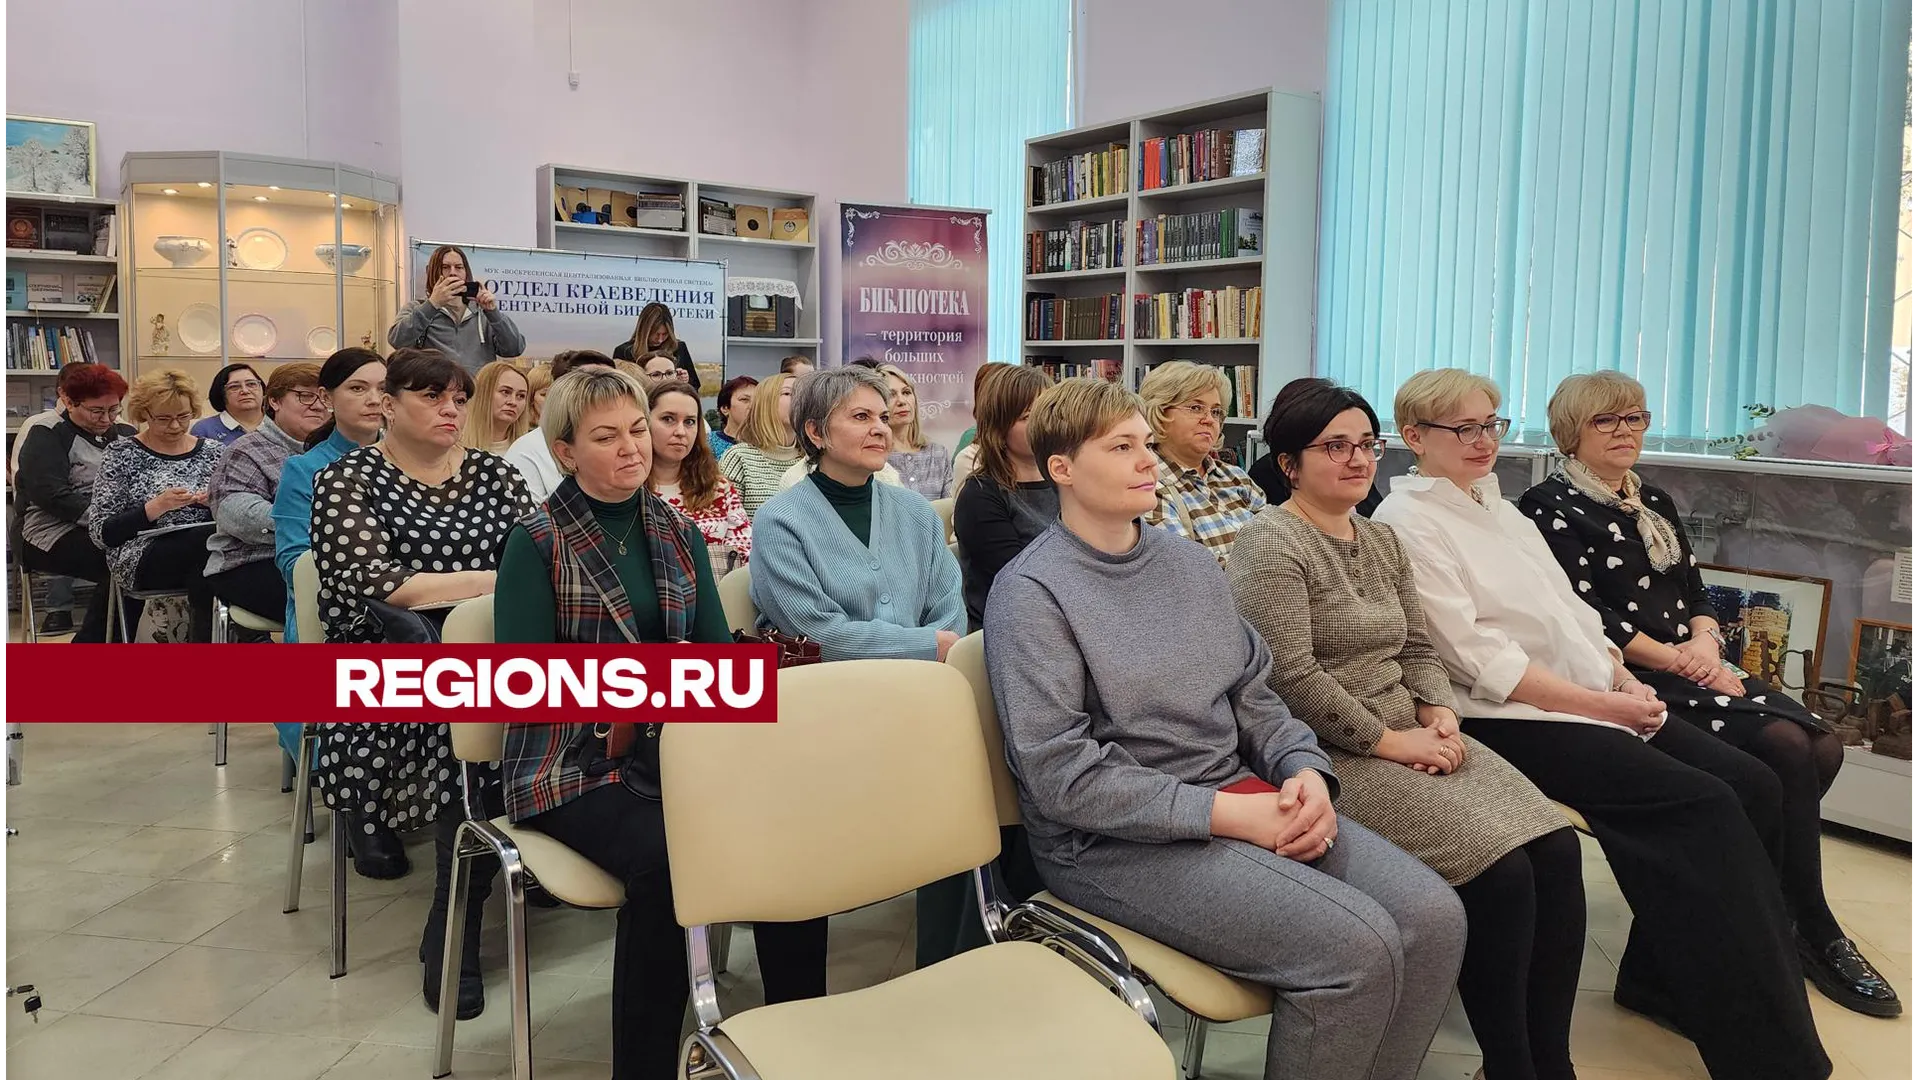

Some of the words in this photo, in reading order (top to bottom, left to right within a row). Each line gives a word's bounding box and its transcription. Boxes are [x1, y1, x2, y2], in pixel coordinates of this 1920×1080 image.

[485, 279, 559, 299] ОТДЕЛ
[566, 283, 715, 305] КРАЕВЕДЕНИЯ
[498, 299, 609, 316] ЕНТРАЛЬНОЙ
[860, 287, 971, 315] БИБЛИОТЕКА
[881, 330, 962, 346] территория
[885, 348, 944, 363] больших
